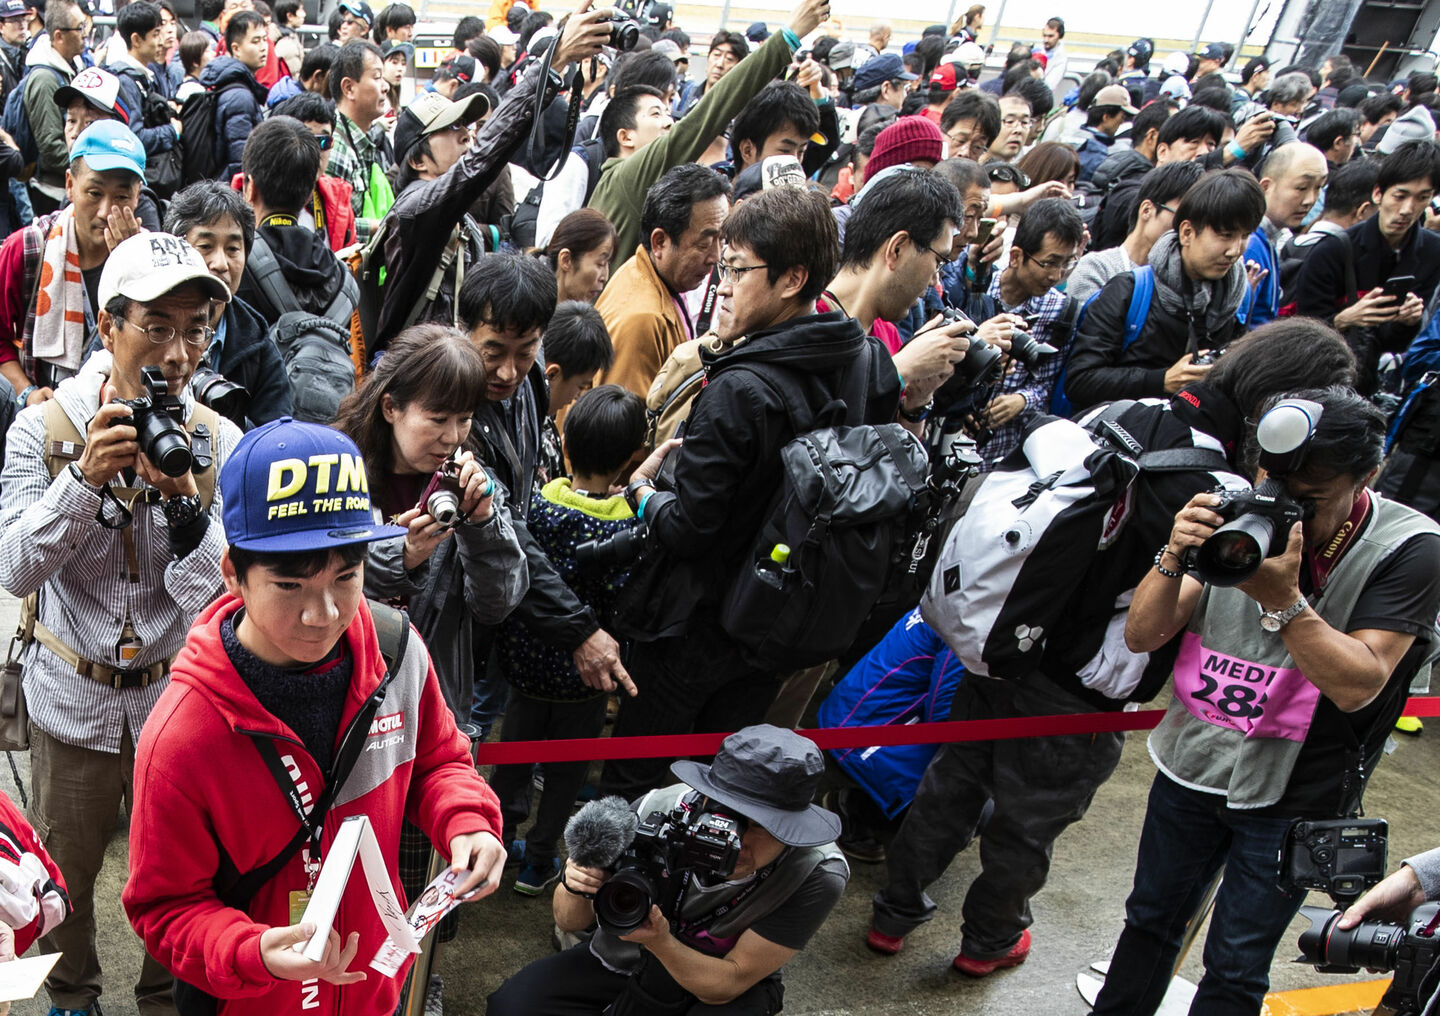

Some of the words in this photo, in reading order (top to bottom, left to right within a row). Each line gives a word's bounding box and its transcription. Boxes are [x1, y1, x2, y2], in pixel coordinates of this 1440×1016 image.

[270, 217, 292, 226] Nikon
[704, 284, 717, 314] Canon
[266, 453, 369, 502] DTM
[268, 501, 308, 520] FEEL
[313, 498, 342, 513] THE
[1323, 521, 1353, 558] Canon
[368, 713, 403, 734] MOTUL
